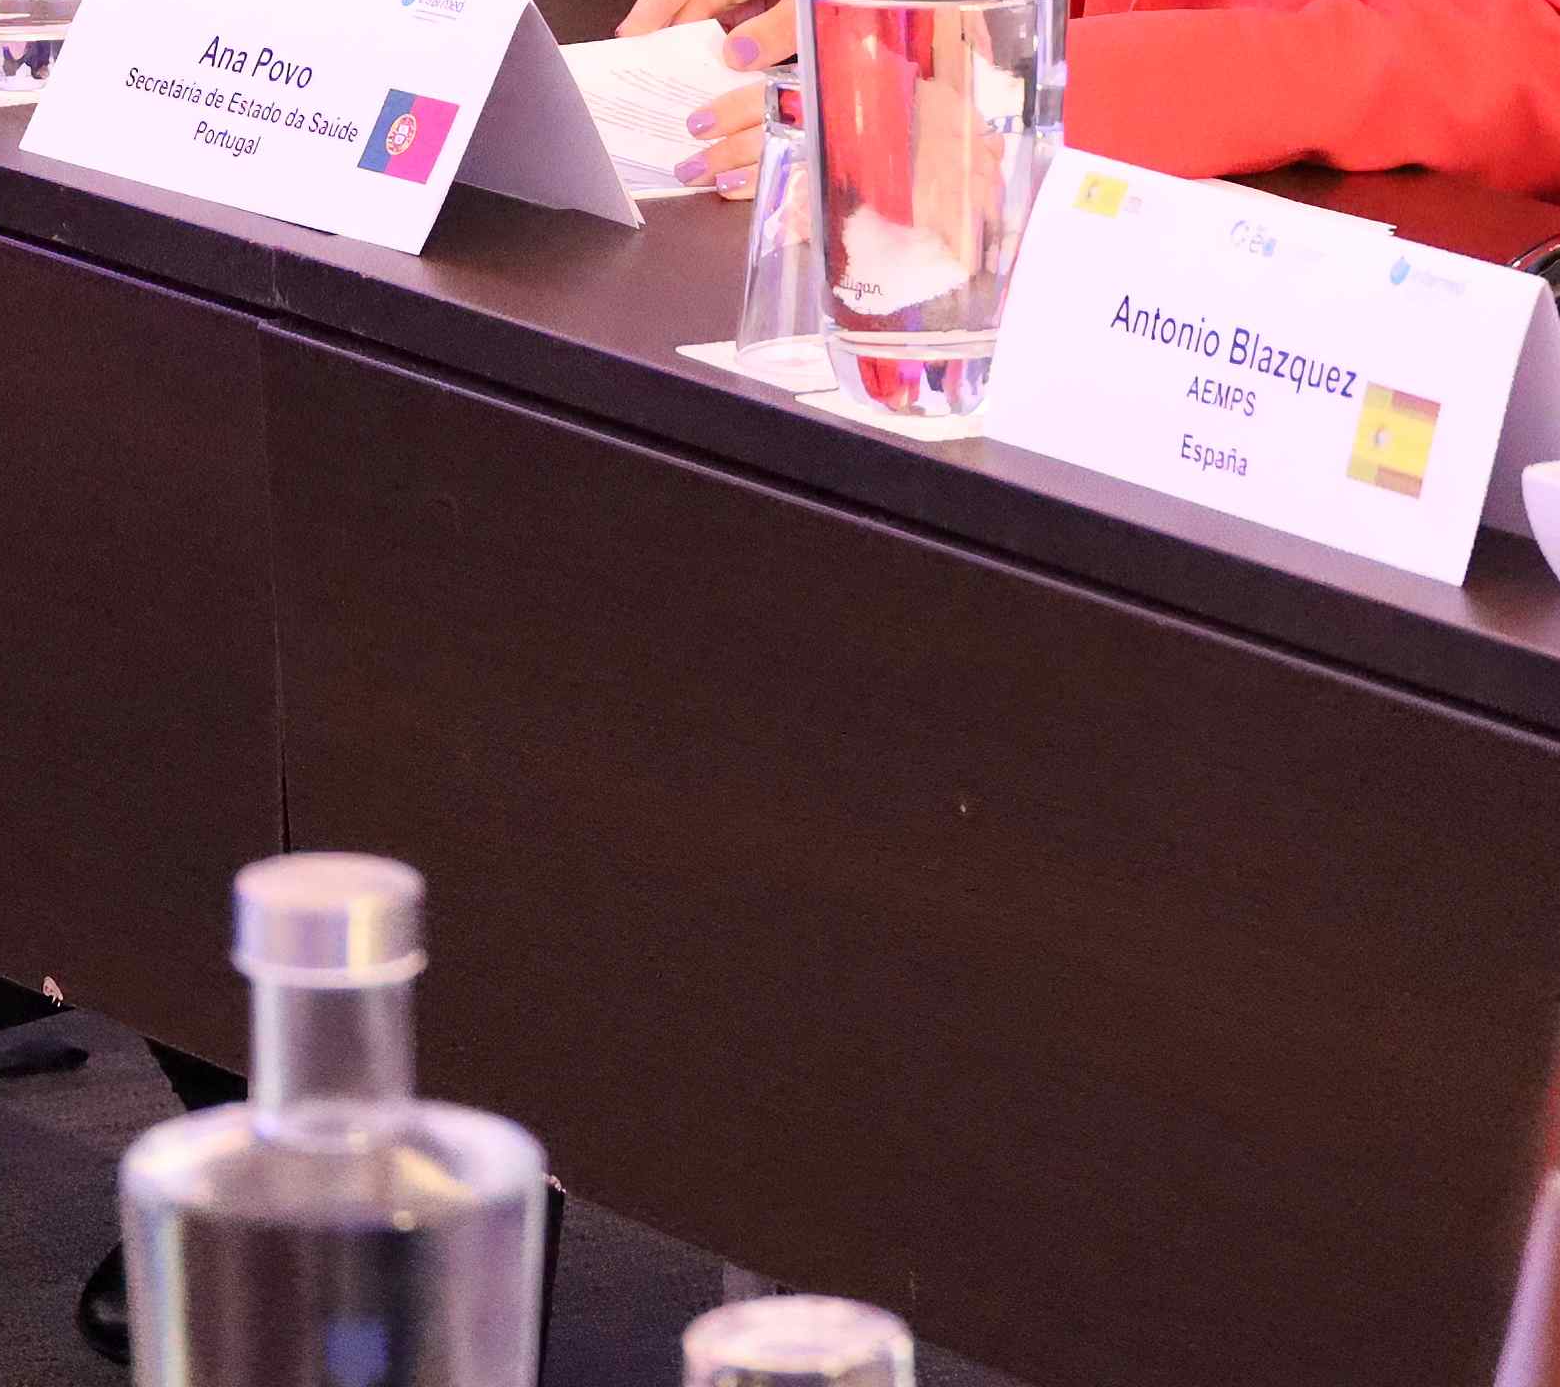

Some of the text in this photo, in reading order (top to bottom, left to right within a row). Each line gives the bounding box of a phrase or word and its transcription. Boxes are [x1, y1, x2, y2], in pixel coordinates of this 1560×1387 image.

[199, 36, 312, 88] Ana Povo
[205, 88, 224, 108] de
[228, 92, 281, 123] Estado
[285, 108, 304, 129] da
[193, 121, 261, 157] Portugal
[1111, 295, 1357, 398] Antonio Blazquez
[1187, 376, 1256, 416] AEMPS
[1181, 434, 1247, 476] España
